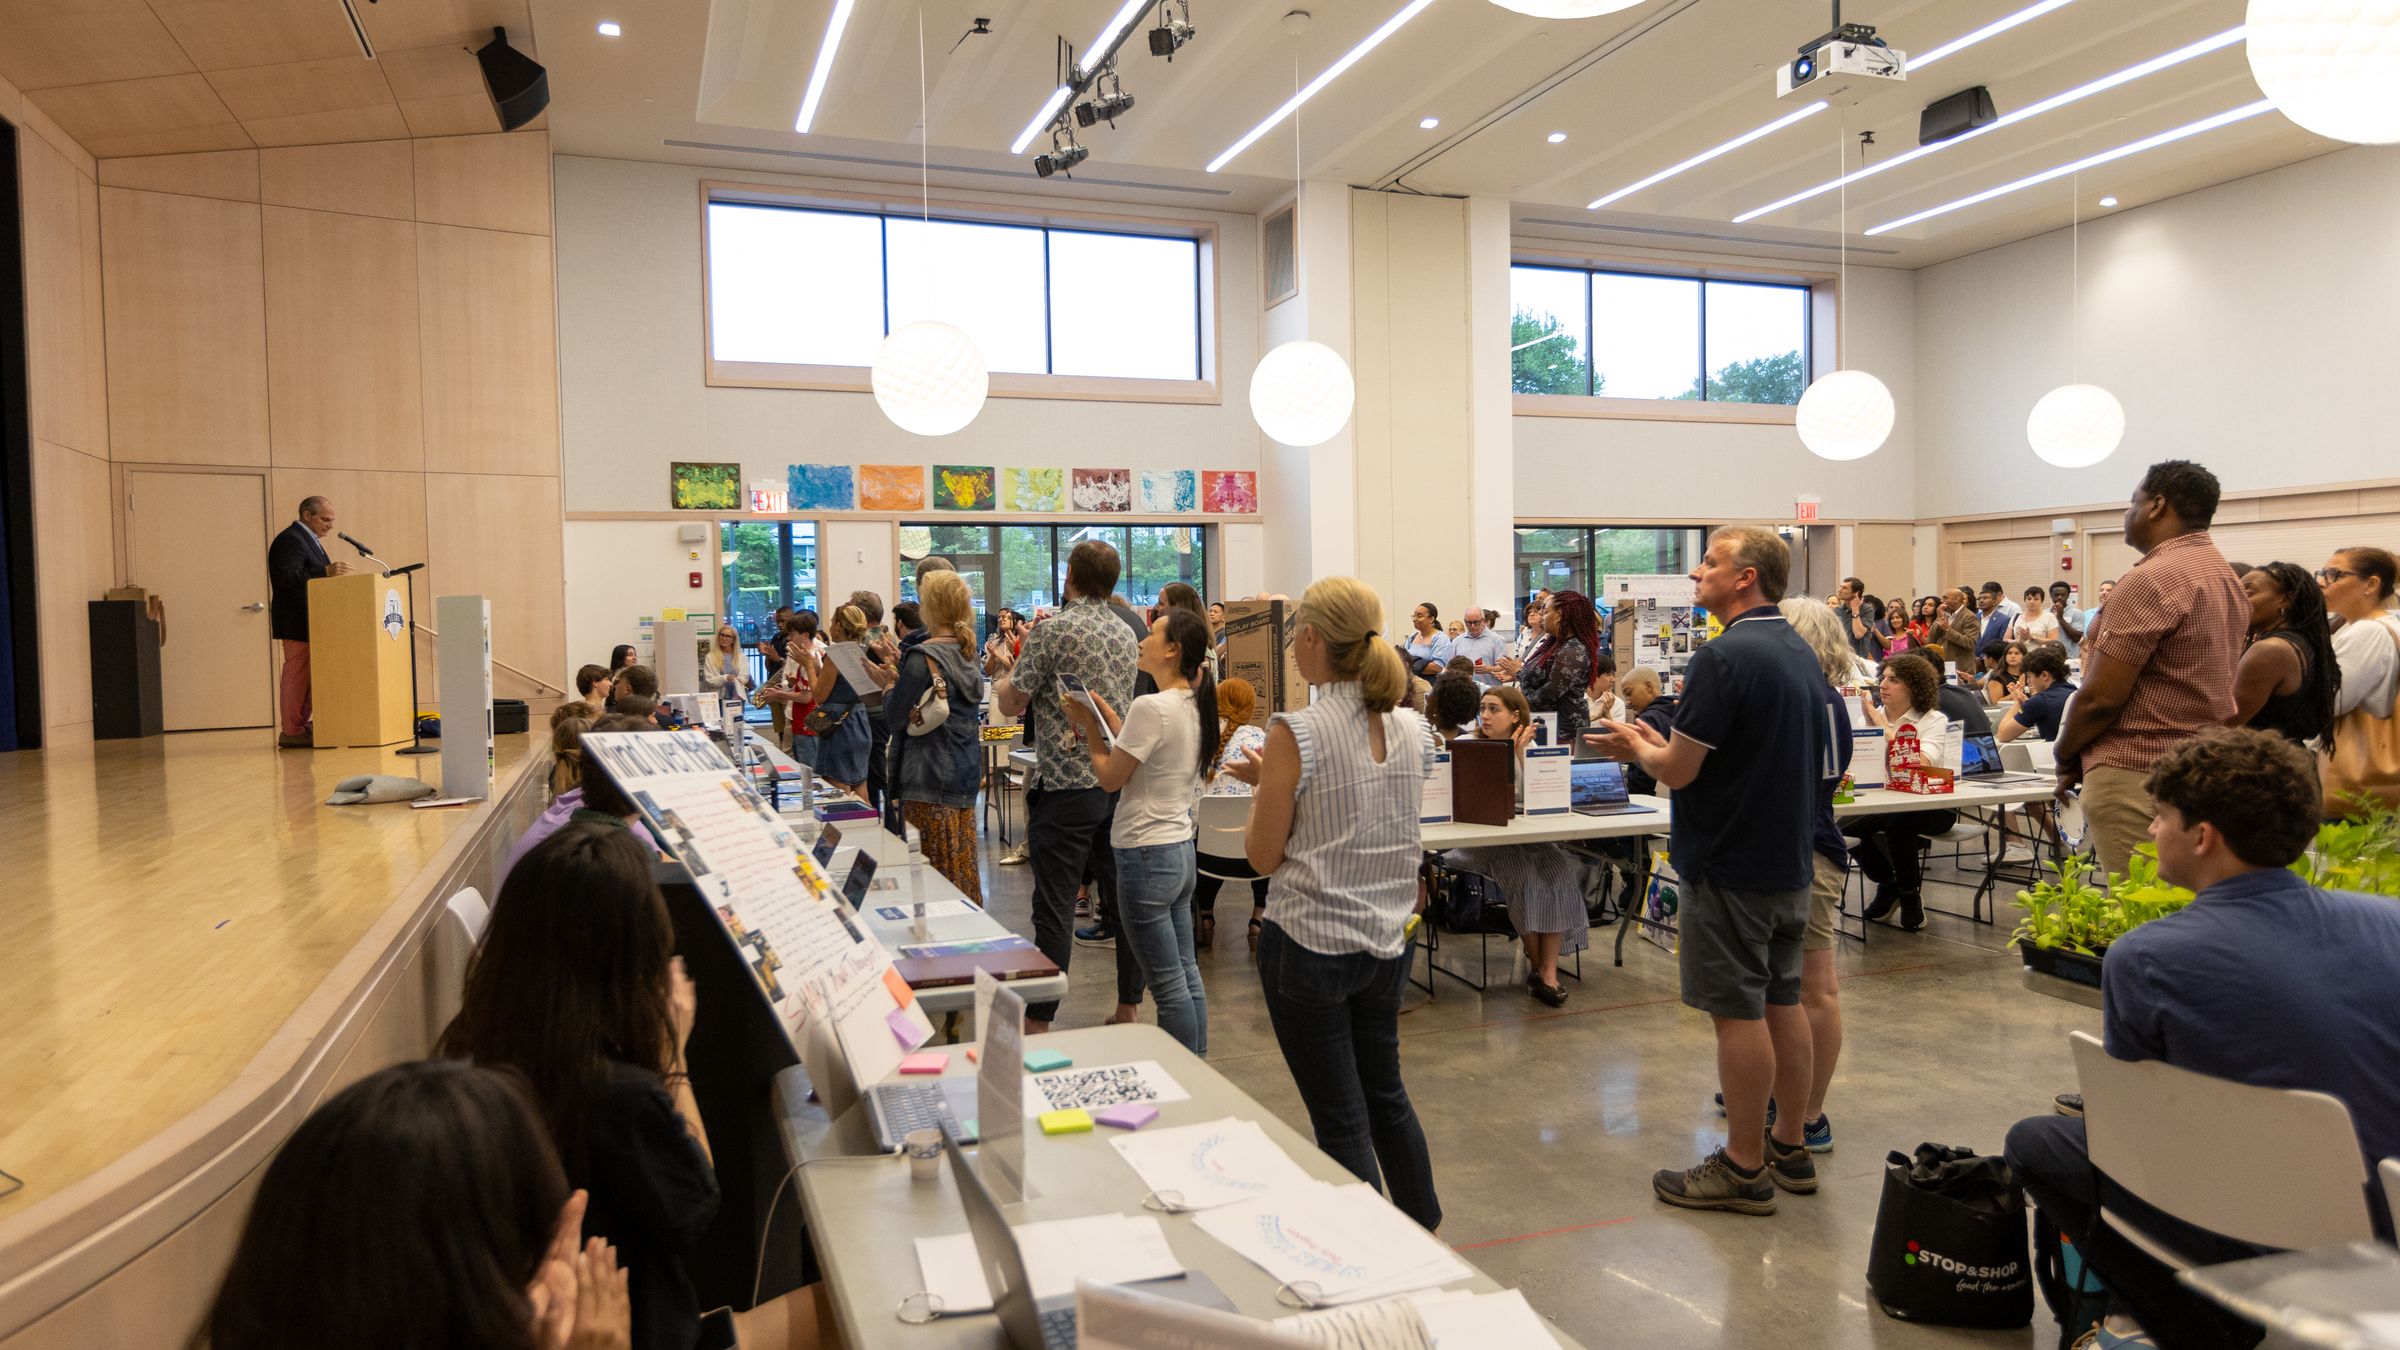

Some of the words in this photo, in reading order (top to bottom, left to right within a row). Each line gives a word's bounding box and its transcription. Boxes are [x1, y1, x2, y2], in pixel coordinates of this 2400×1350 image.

[756, 490, 784, 511] EXIT
[1800, 503, 1816, 519] EXIT
[1226, 622, 1250, 634] DISPLAY
[1250, 616, 1271, 628] BOARD
[1918, 1249, 2018, 1278] STOP&SHOP
[1956, 1278, 1980, 1293] feed
[1980, 1280, 2000, 1294] the
